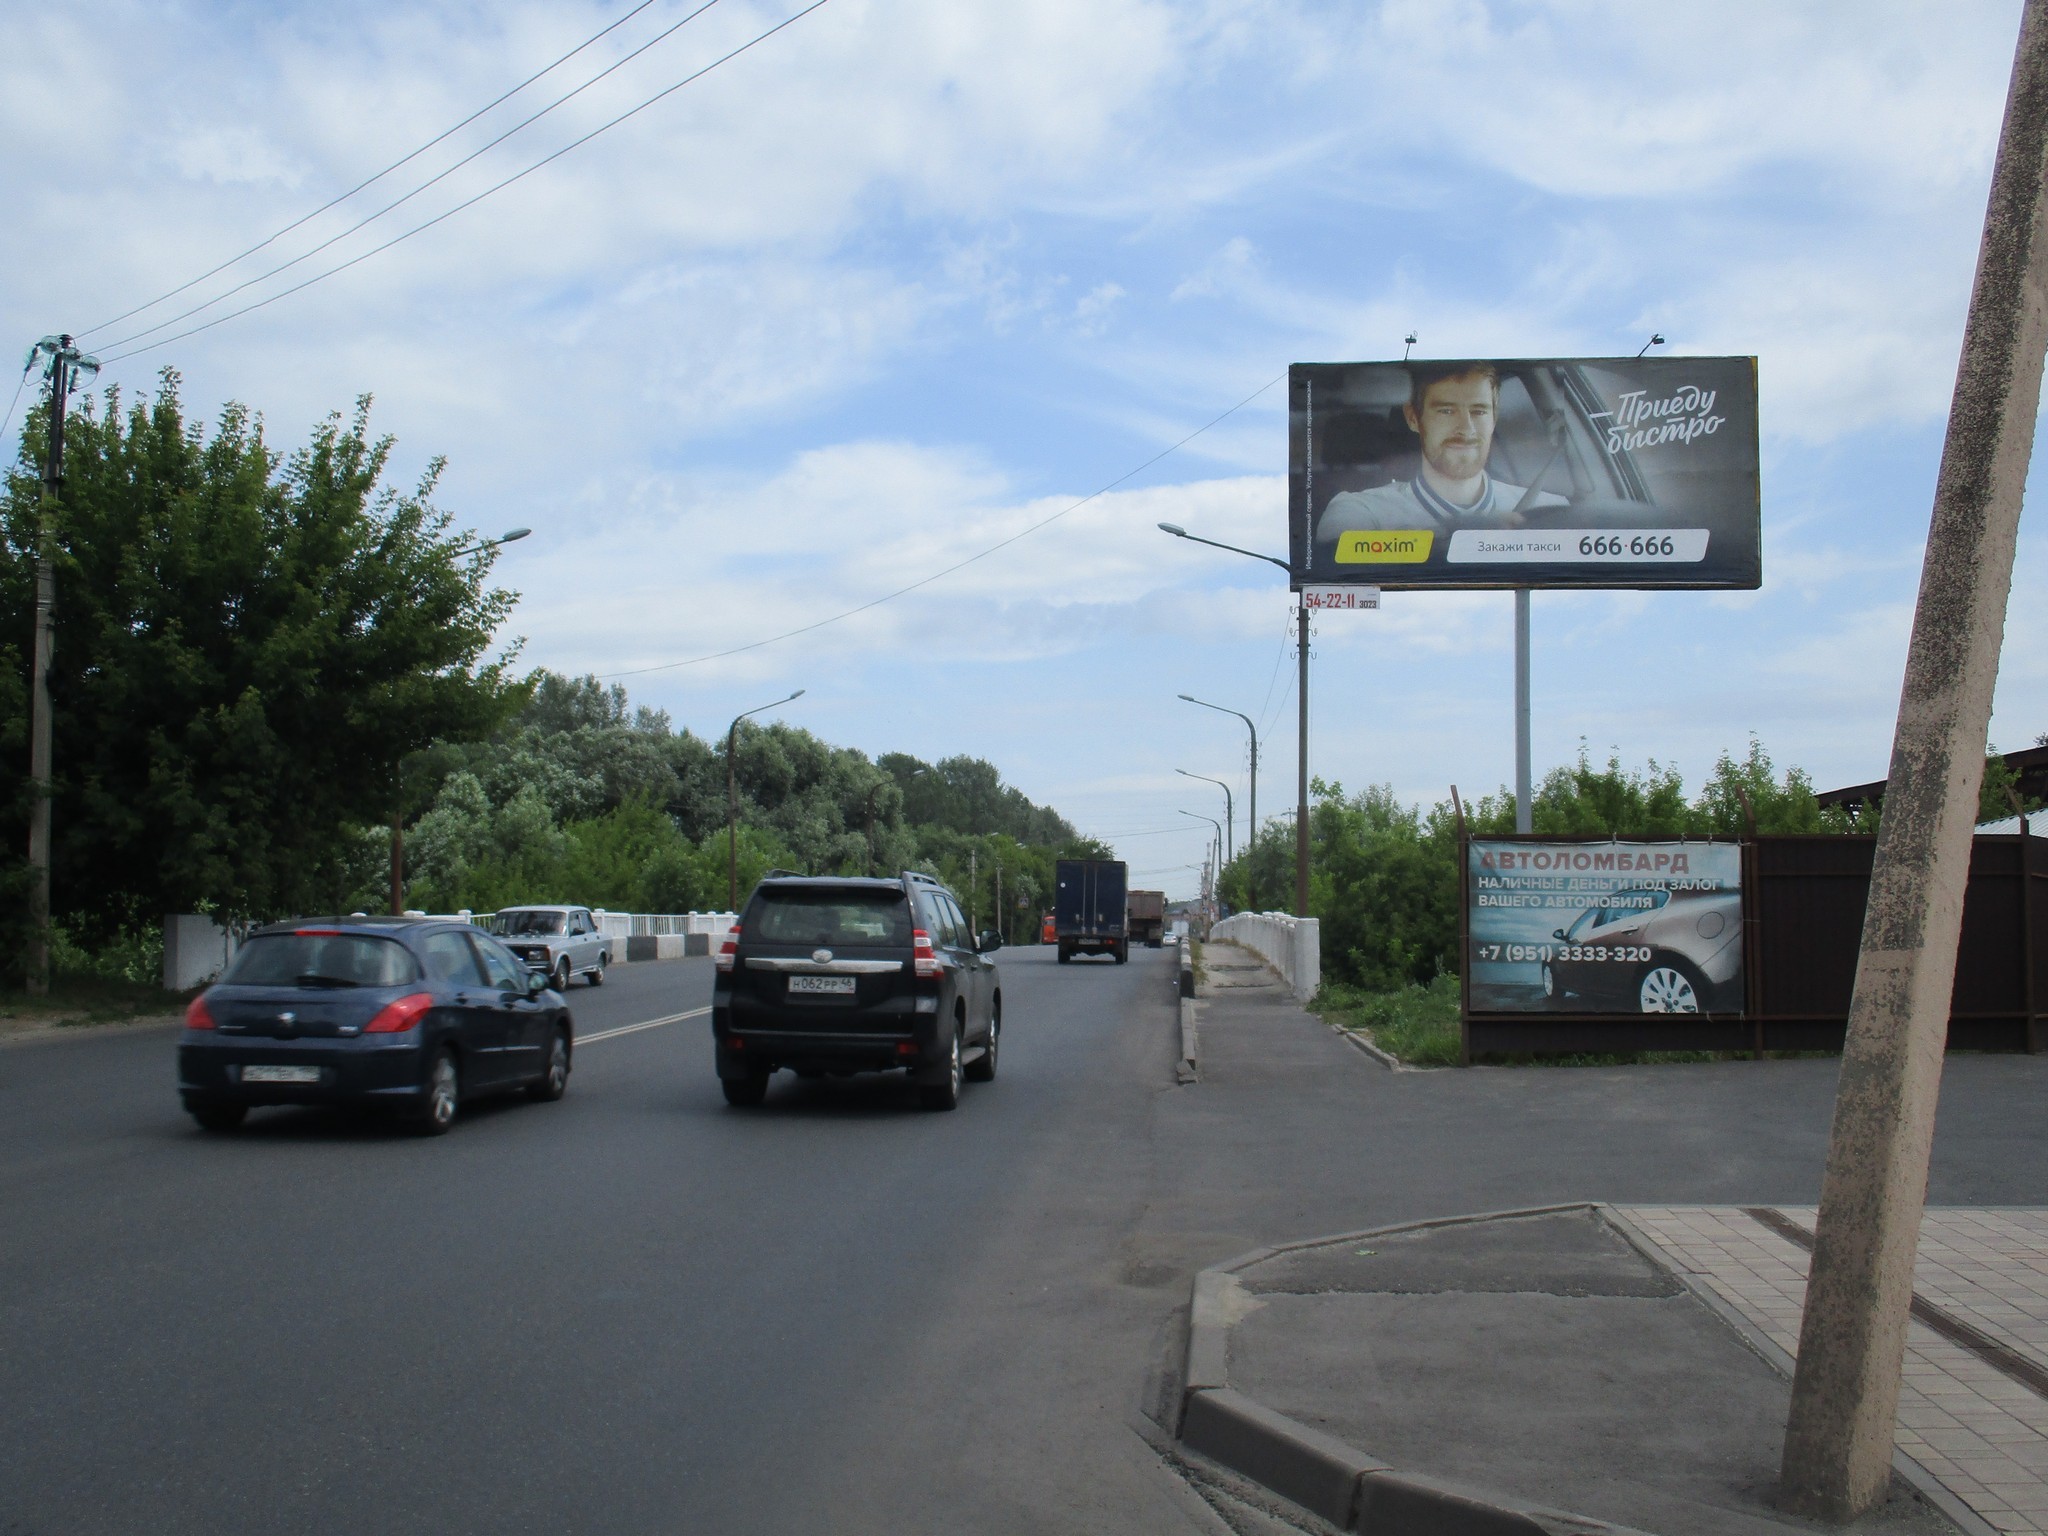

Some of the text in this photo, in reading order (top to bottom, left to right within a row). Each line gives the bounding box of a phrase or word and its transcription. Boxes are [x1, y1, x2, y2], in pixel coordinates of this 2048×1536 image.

[1617, 385, 1717, 428] Приеду
[1607, 415, 1726, 455] быстро
[1354, 538, 1414, 553] maxim
[1477, 541, 1561, 553] Закажи такси
[1306, 593, 1377, 609] 54-22-11 3023
[1479, 851, 1690, 874] АВТОЛОМБАРД
[1478, 876, 1721, 892] НАЛИЧНЫЕ ДЕНЬГИ ПОД ЗАЛОГ
[1478, 895, 1653, 909] ВАШЕГО АВТОМОБИЛЯ
[1479, 944, 1652, 963] +7 (951) 3333-320
